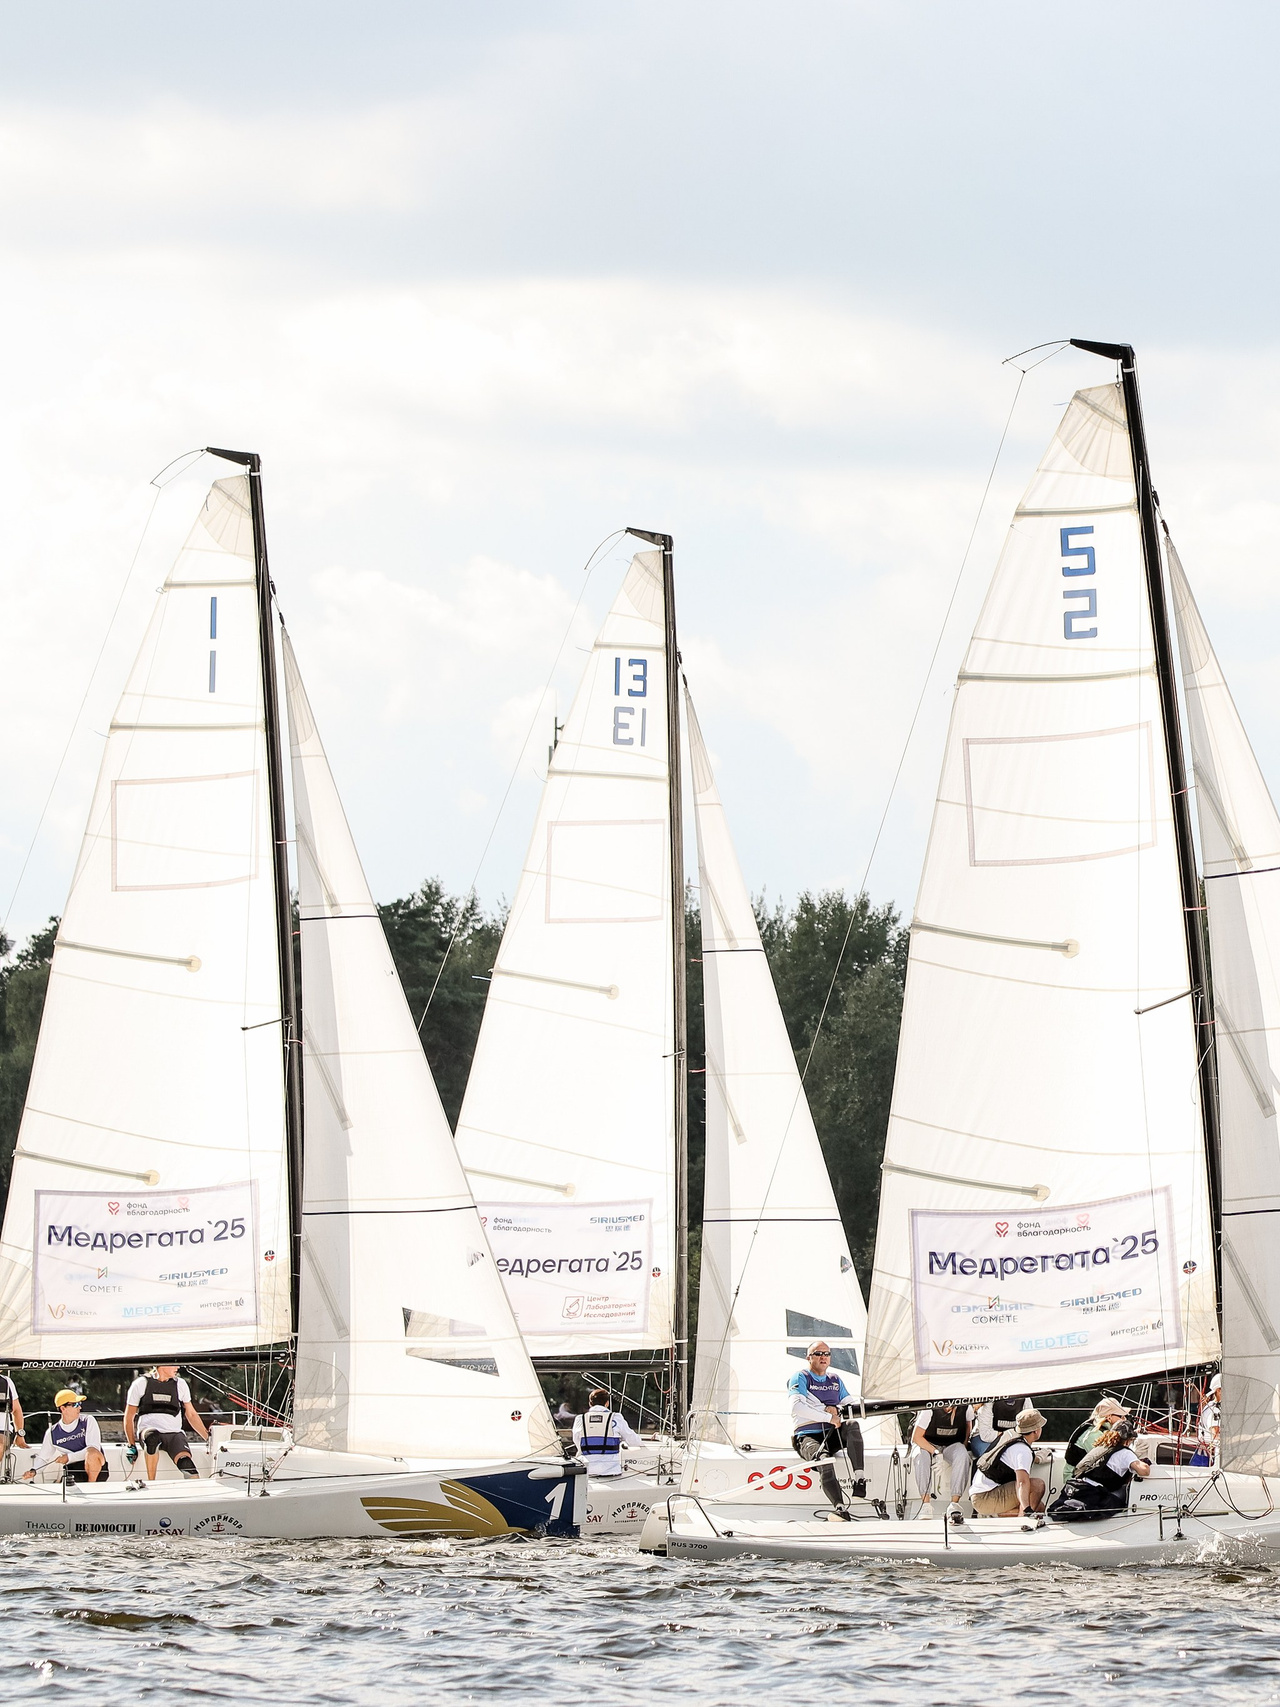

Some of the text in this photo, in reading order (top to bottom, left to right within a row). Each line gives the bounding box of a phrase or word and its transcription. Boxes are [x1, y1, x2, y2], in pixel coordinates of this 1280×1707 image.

[1060, 525, 1096, 577] 5
[210, 596, 217, 639] 1
[614, 657, 647, 697] 13
[126, 1202, 148, 1210] фонд
[590, 1214, 645, 1224] SIRIUSMED
[1016, 1221, 1041, 1230] фонд
[1016, 1225, 1092, 1238] вблагодарность
[158, 1267, 229, 1281] SIRIUSMED
[82, 1284, 123, 1293] COMETE
[1060, 1287, 1142, 1308] SIRIUSMED
[123, 1303, 182, 1317] MEDTEC
[585, 1302, 637, 1310] Лабораторных
[972, 1314, 1018, 1324] COMETE
[1020, 1333, 1089, 1351] MEDTEC
[545, 1482, 567, 1521] 1
[611, 1502, 651, 1518] МОРПРИБО
[193, 1514, 243, 1532] МОРПРИБОР
